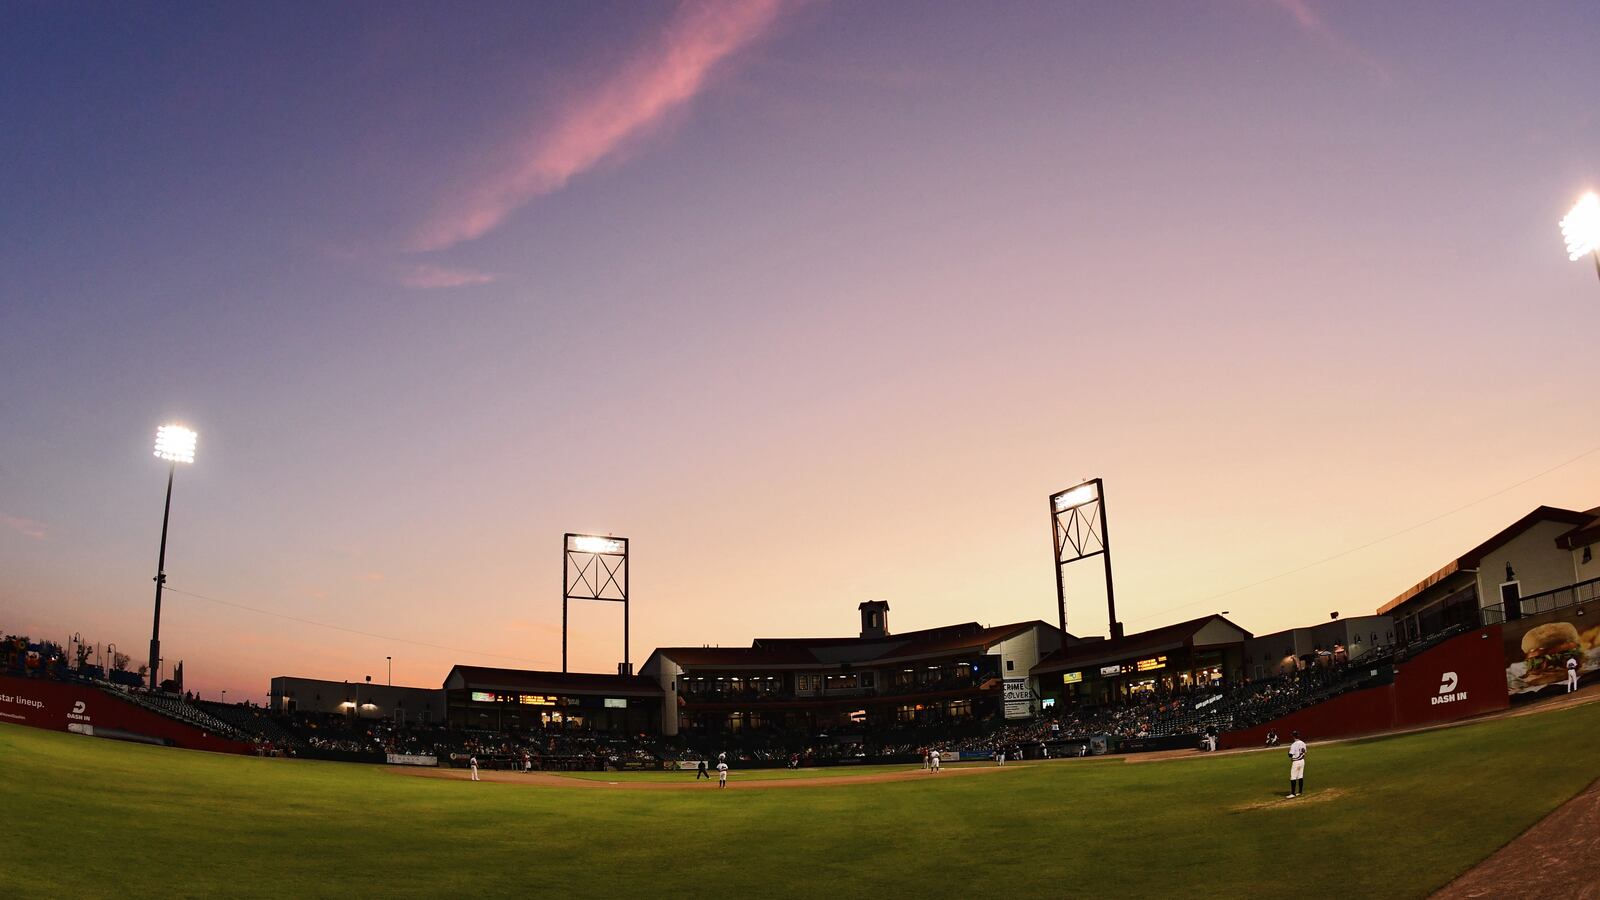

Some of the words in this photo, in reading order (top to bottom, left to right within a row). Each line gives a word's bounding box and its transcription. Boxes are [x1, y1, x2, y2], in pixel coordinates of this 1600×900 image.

[1003, 683, 1024, 691] CRIME
[1003, 691, 1033, 699] SOLVERS
[1431, 693, 1456, 705] DASH
[1456, 691, 1467, 701] IN
[16, 695, 45, 709] lineup.
[66, 712, 83, 721] DASH
[83, 714, 91, 722] IN
